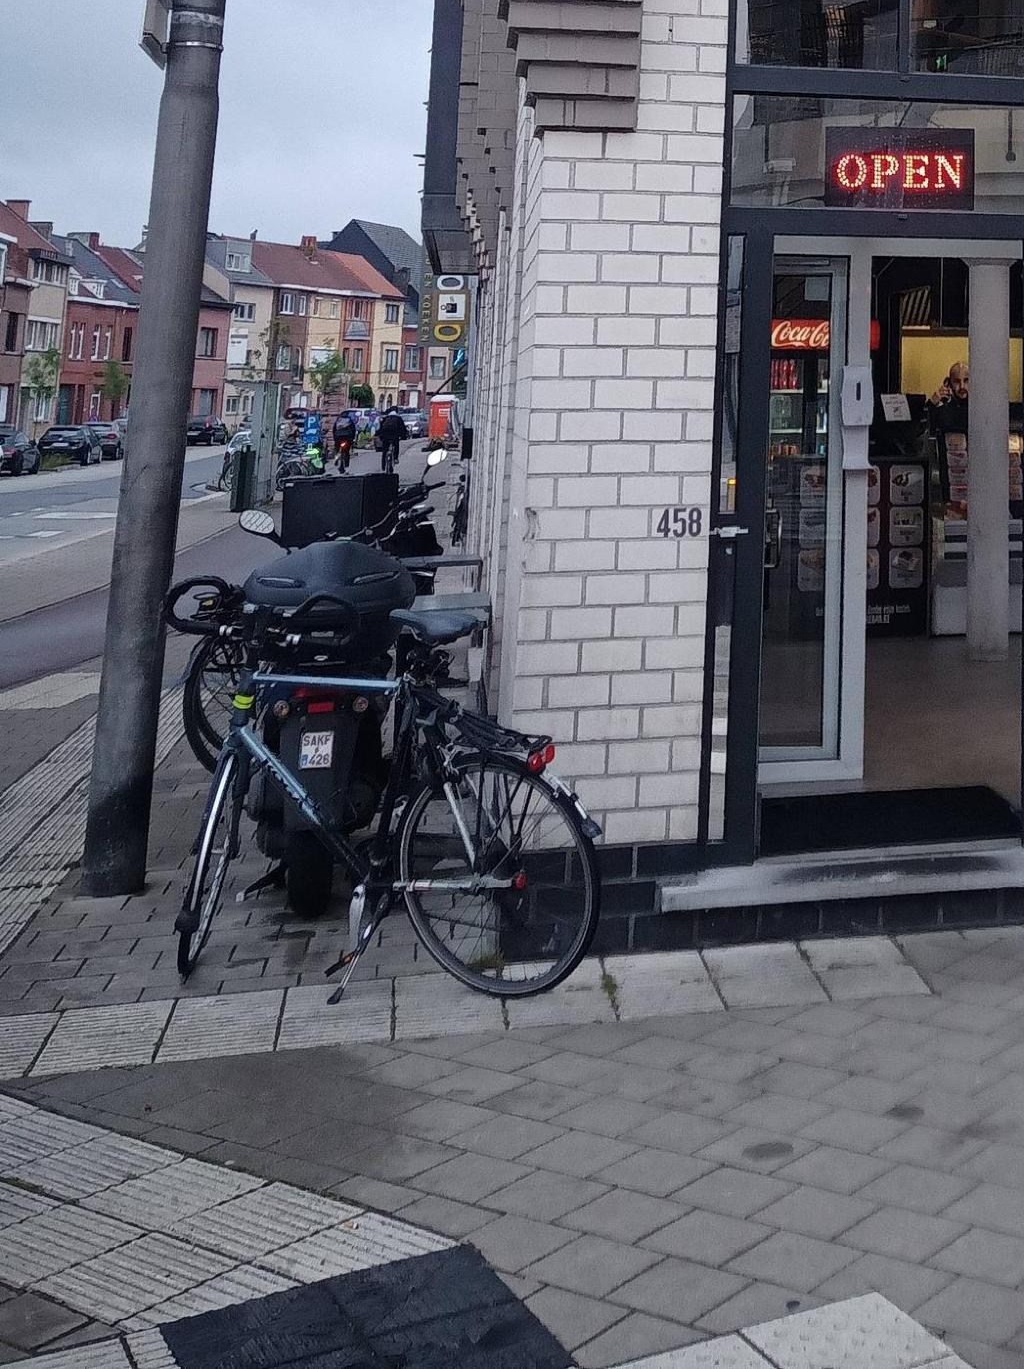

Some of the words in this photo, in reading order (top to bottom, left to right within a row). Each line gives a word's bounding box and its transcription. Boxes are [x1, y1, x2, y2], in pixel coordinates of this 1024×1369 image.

[836, 153, 964, 189] OPEN
[771, 320, 829, 348] Coca-Co
[656, 507, 702, 538] 458
